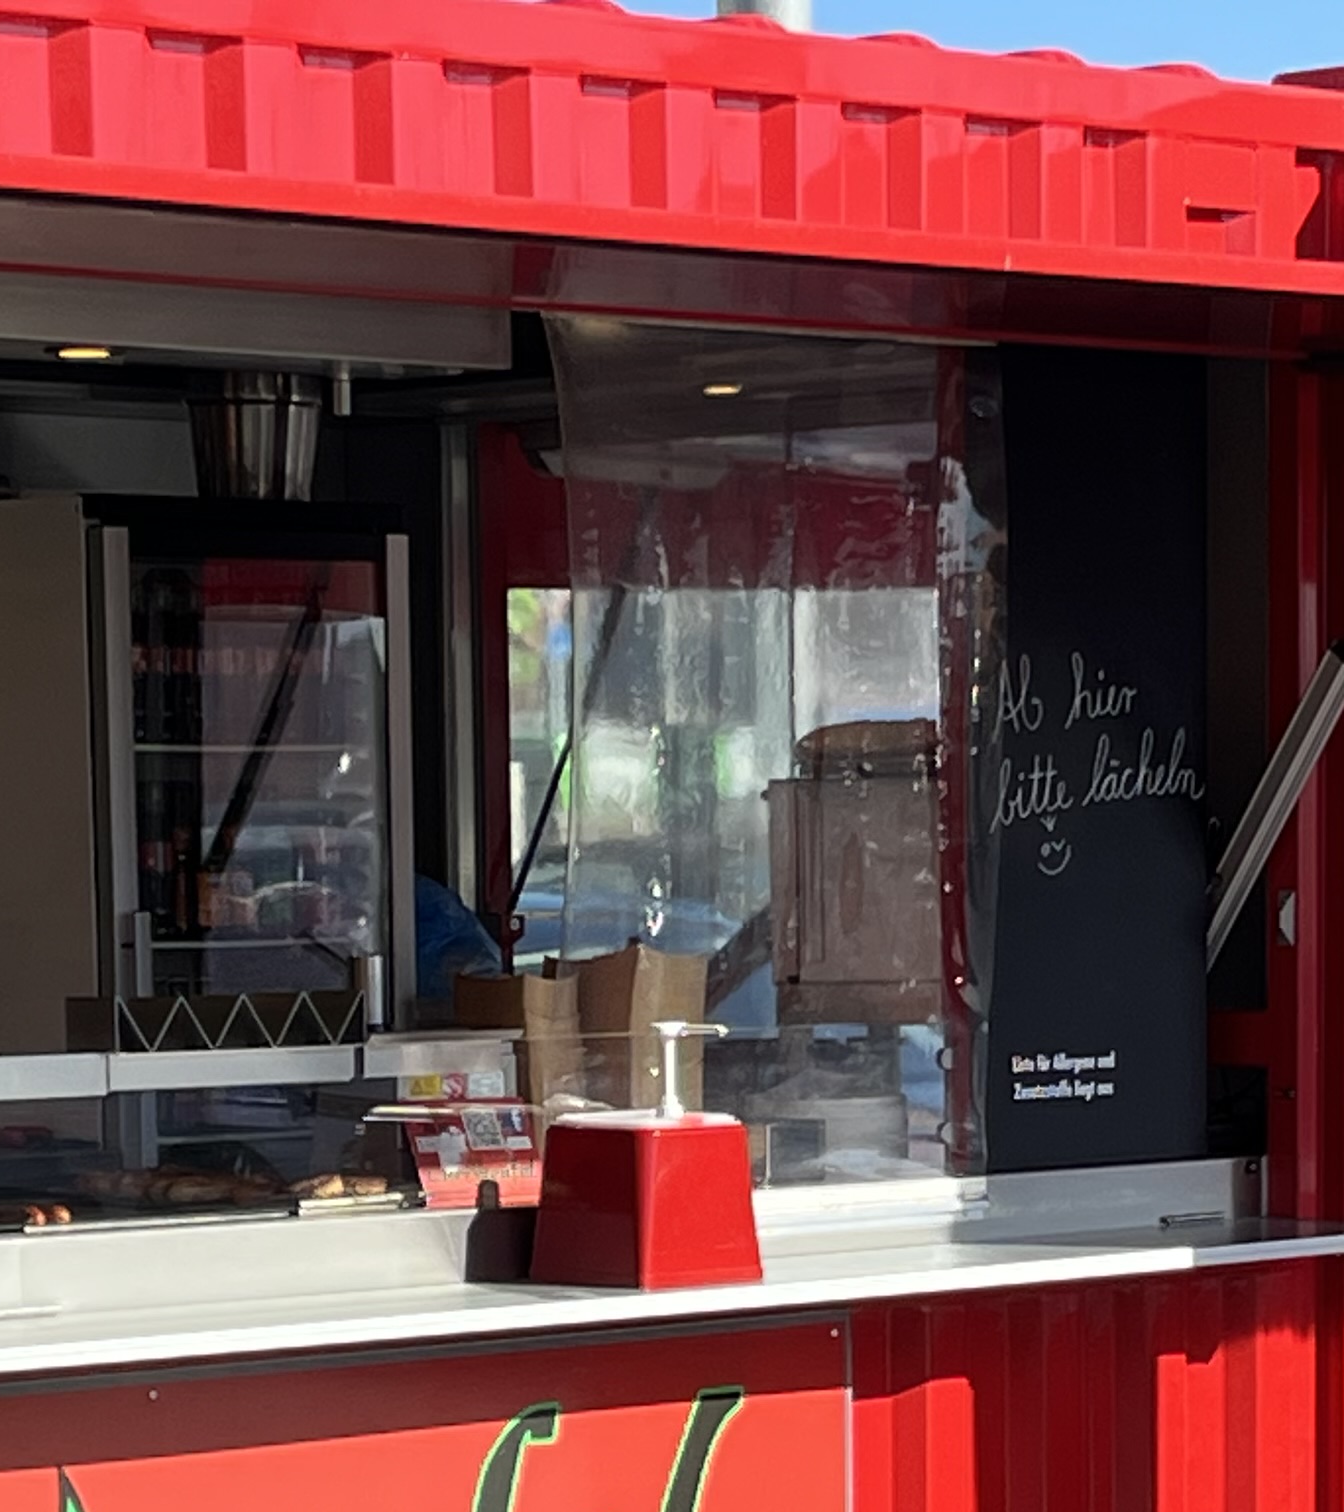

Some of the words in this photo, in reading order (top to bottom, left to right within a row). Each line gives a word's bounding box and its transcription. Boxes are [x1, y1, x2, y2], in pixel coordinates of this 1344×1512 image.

[992, 653, 1043, 743] Ab
[1064, 652, 1137, 730] hier
[989, 754, 1073, 834] bitte
[1082, 727, 1205, 807] lächeln
